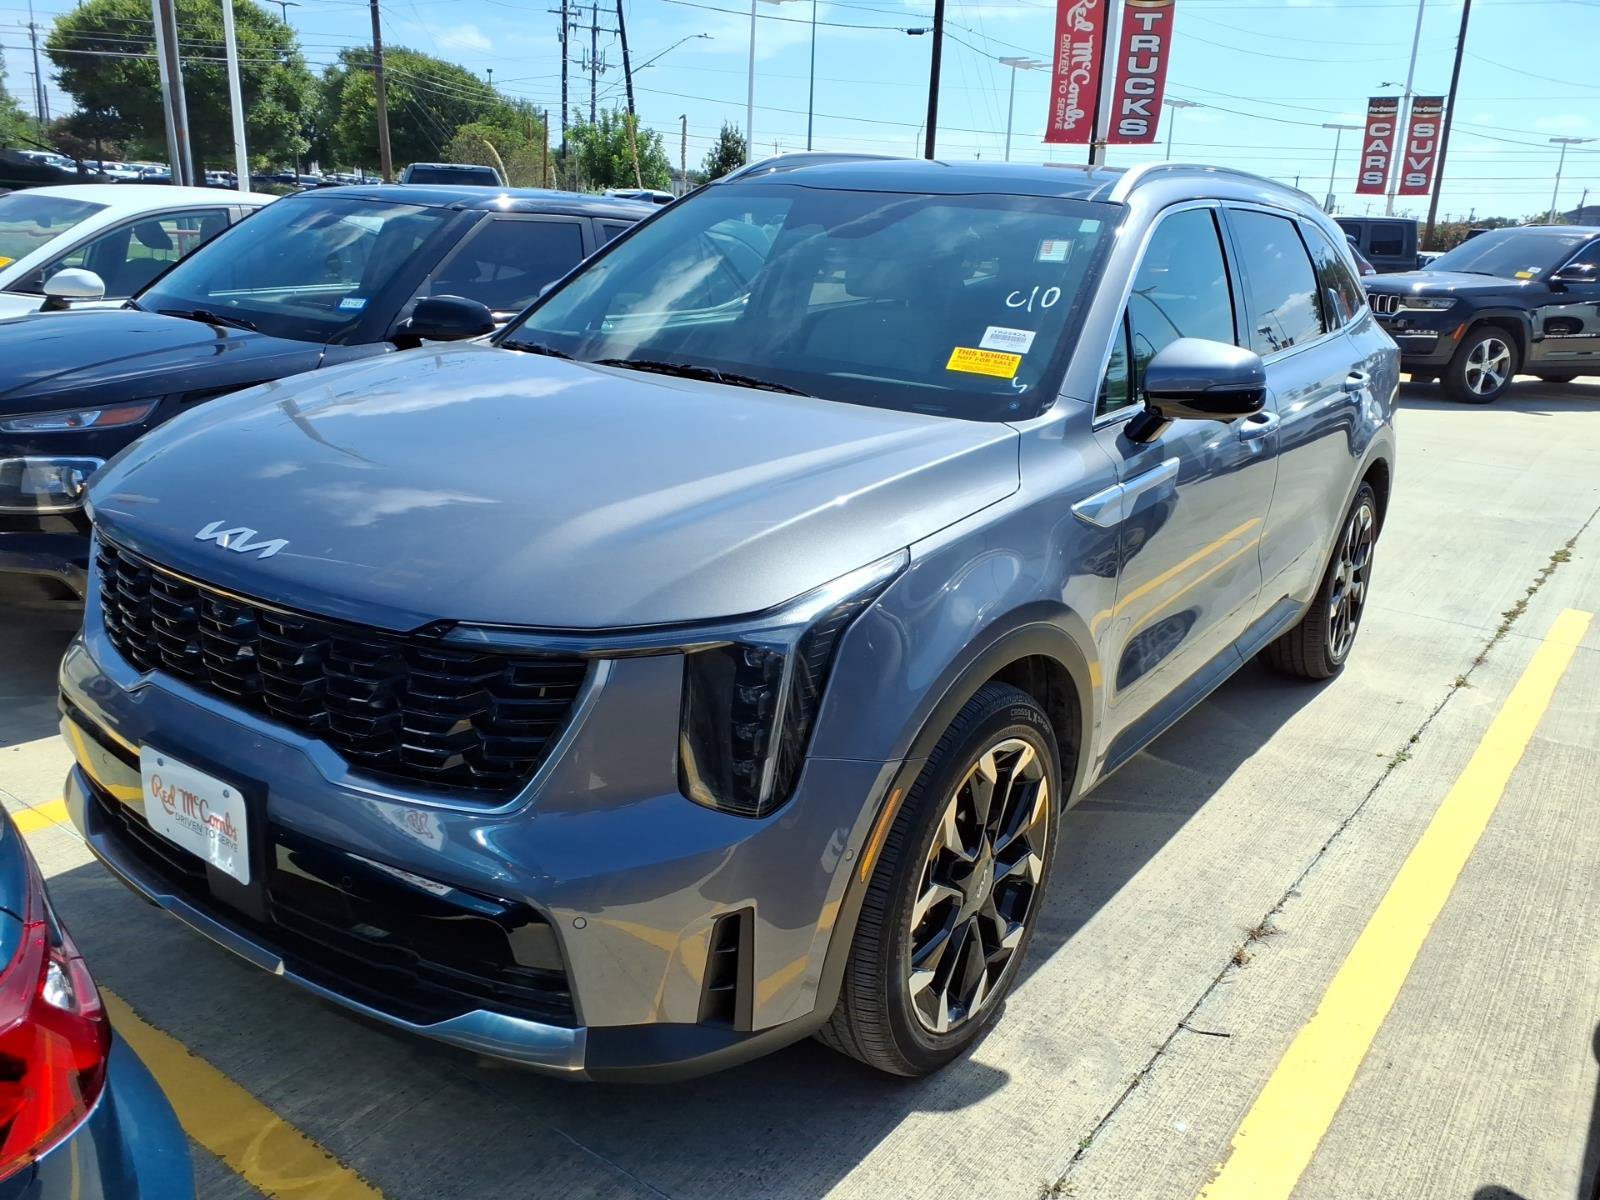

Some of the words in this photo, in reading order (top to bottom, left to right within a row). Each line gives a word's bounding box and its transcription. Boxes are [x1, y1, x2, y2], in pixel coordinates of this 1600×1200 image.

[1060, 34, 1071, 75] DRIVEN
[1058, 79, 1068, 94] TO
[1064, 35, 1094, 130] McCombs
[1118, 13, 1163, 136] TRUCKS
[1055, 97, 1066, 130] SERVE
[1362, 123, 1391, 184] CARS
[1404, 123, 1435, 186] SUVS
[958, 348, 977, 357] THIS
[980, 351, 1018, 362] VEHICLE
[974, 356, 992, 364] FOR
[993, 359, 1015, 367] SALE
[1028, 709, 1038, 724] LX
[151, 774, 176, 815] Red
[178, 787, 238, 841] McCombs
[175, 812, 202, 833] DRIVEN
[204, 827, 216, 839] TO
